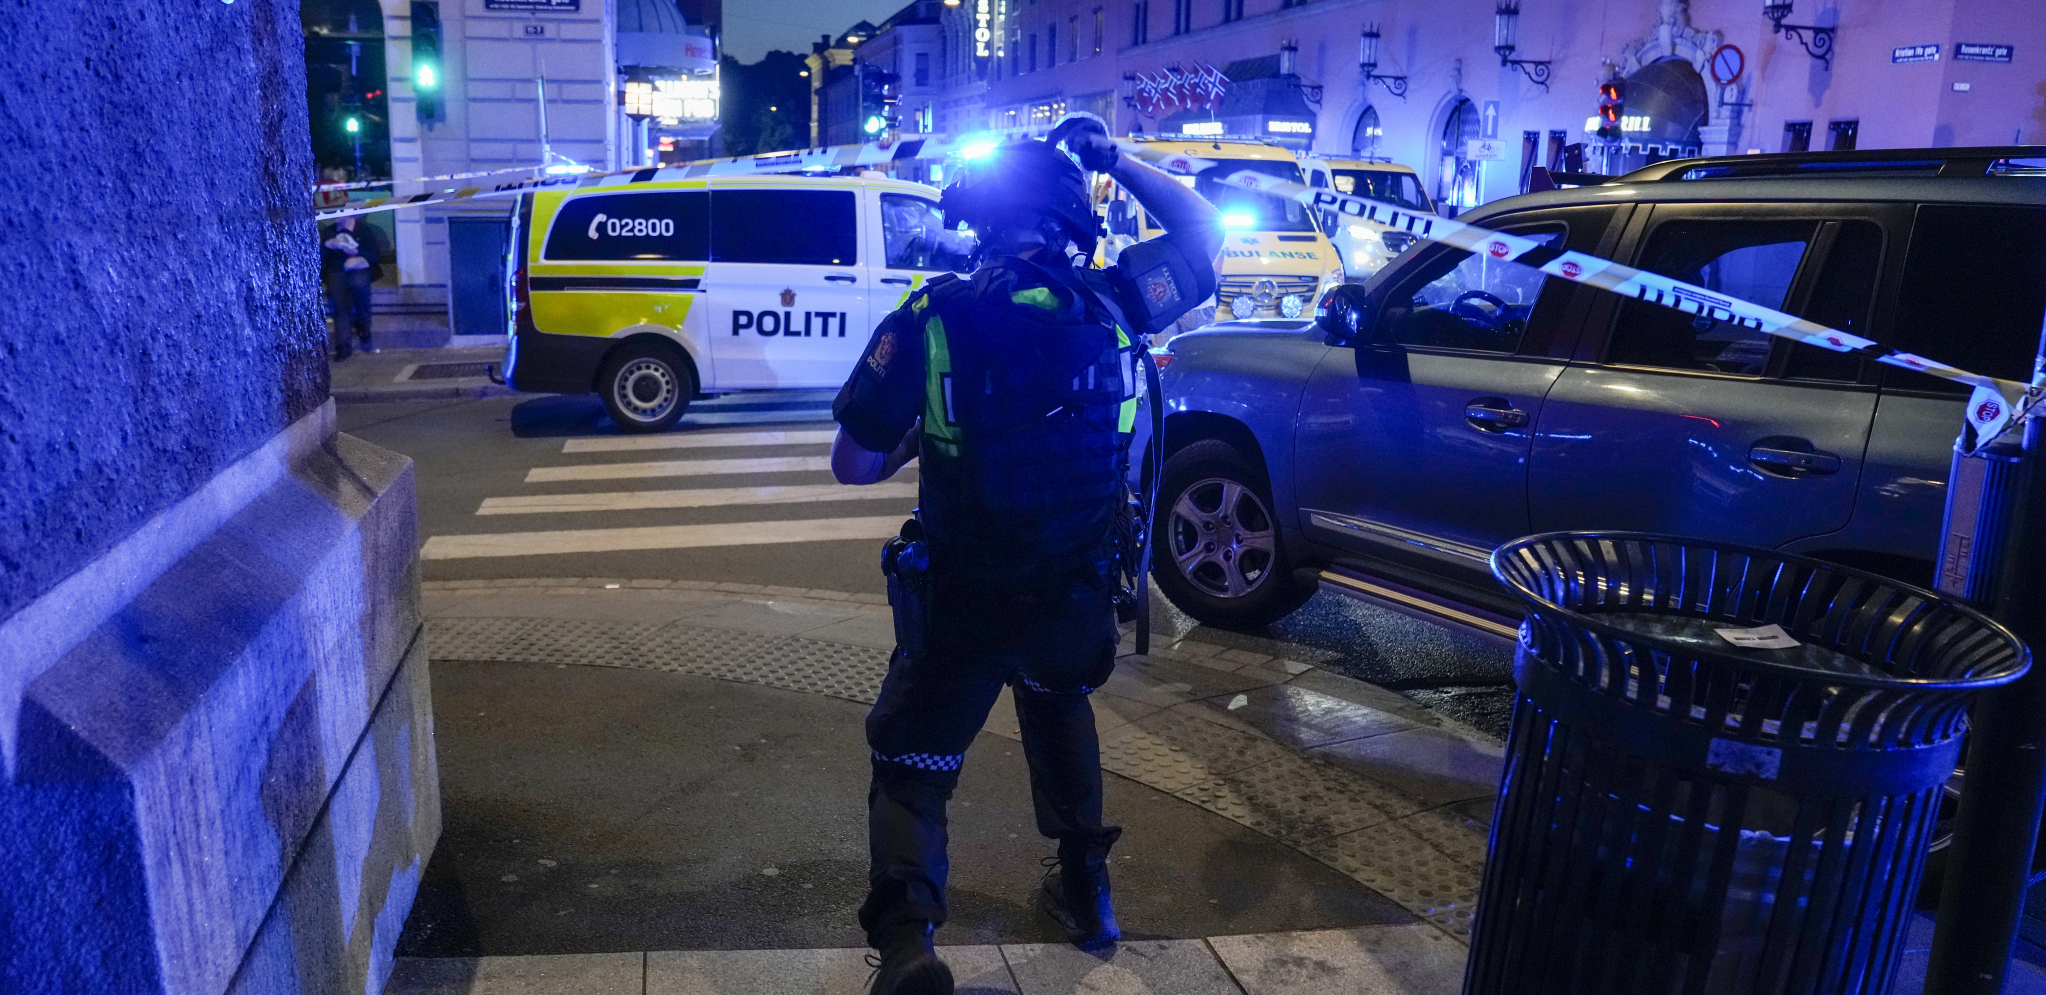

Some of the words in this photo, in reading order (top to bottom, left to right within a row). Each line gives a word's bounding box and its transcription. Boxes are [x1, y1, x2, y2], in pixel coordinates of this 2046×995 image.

[1924, 46, 1936, 58] gate
[1995, 47, 2007, 57] gate
[1268, 121, 1312, 133] BRISTOL
[1620, 115, 1651, 132] RILL
[1313, 191, 1433, 237] POLITI
[607, 218, 675, 236] 02800
[1489, 243, 1509, 255] STOP
[1162, 267, 1180, 301] POLITI
[732, 310, 846, 337] POLITI
[867, 356, 887, 377] POLITI
[1980, 402, 1998, 422] STOP
